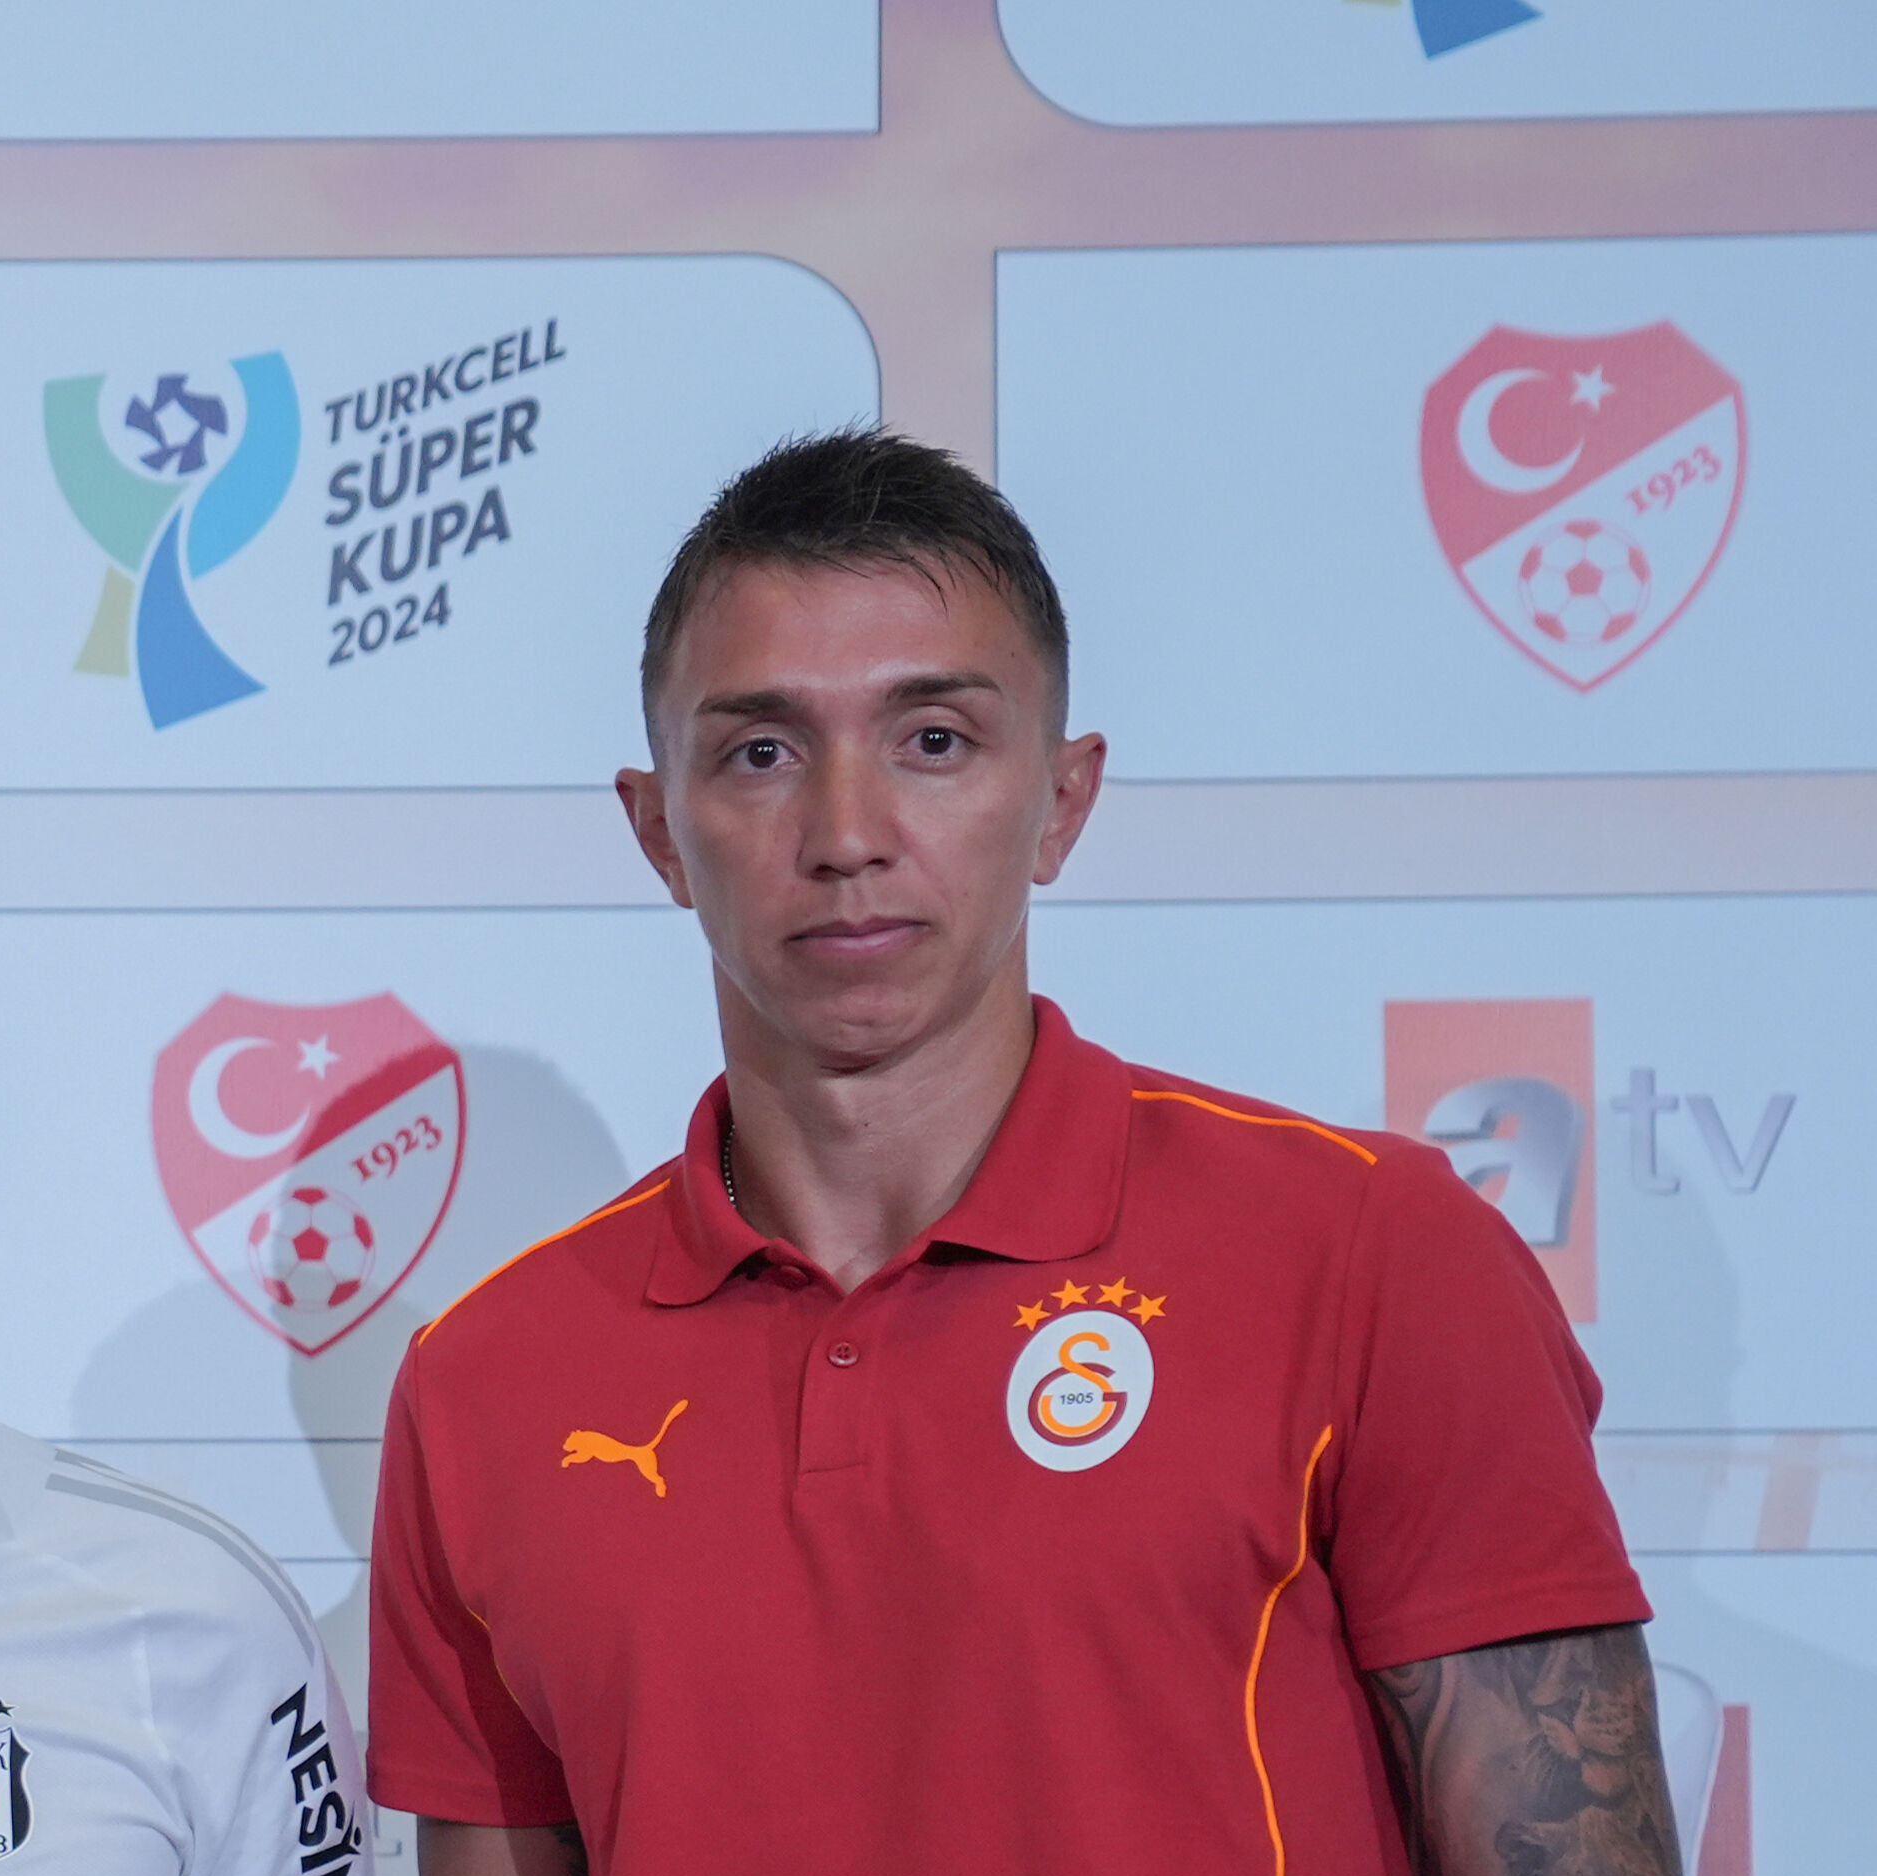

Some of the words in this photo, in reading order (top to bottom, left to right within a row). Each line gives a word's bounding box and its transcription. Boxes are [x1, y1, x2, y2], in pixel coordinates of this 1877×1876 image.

[324, 316, 567, 444] TURKCELL
[325, 397, 541, 527] SÜPER
[1625, 444, 1722, 514] 1923
[327, 486, 512, 606] KUPA
[327, 584, 452, 667] 2024
[349, 1113, 443, 1184] 1923
[1059, 1392, 1094, 1406] 1905
